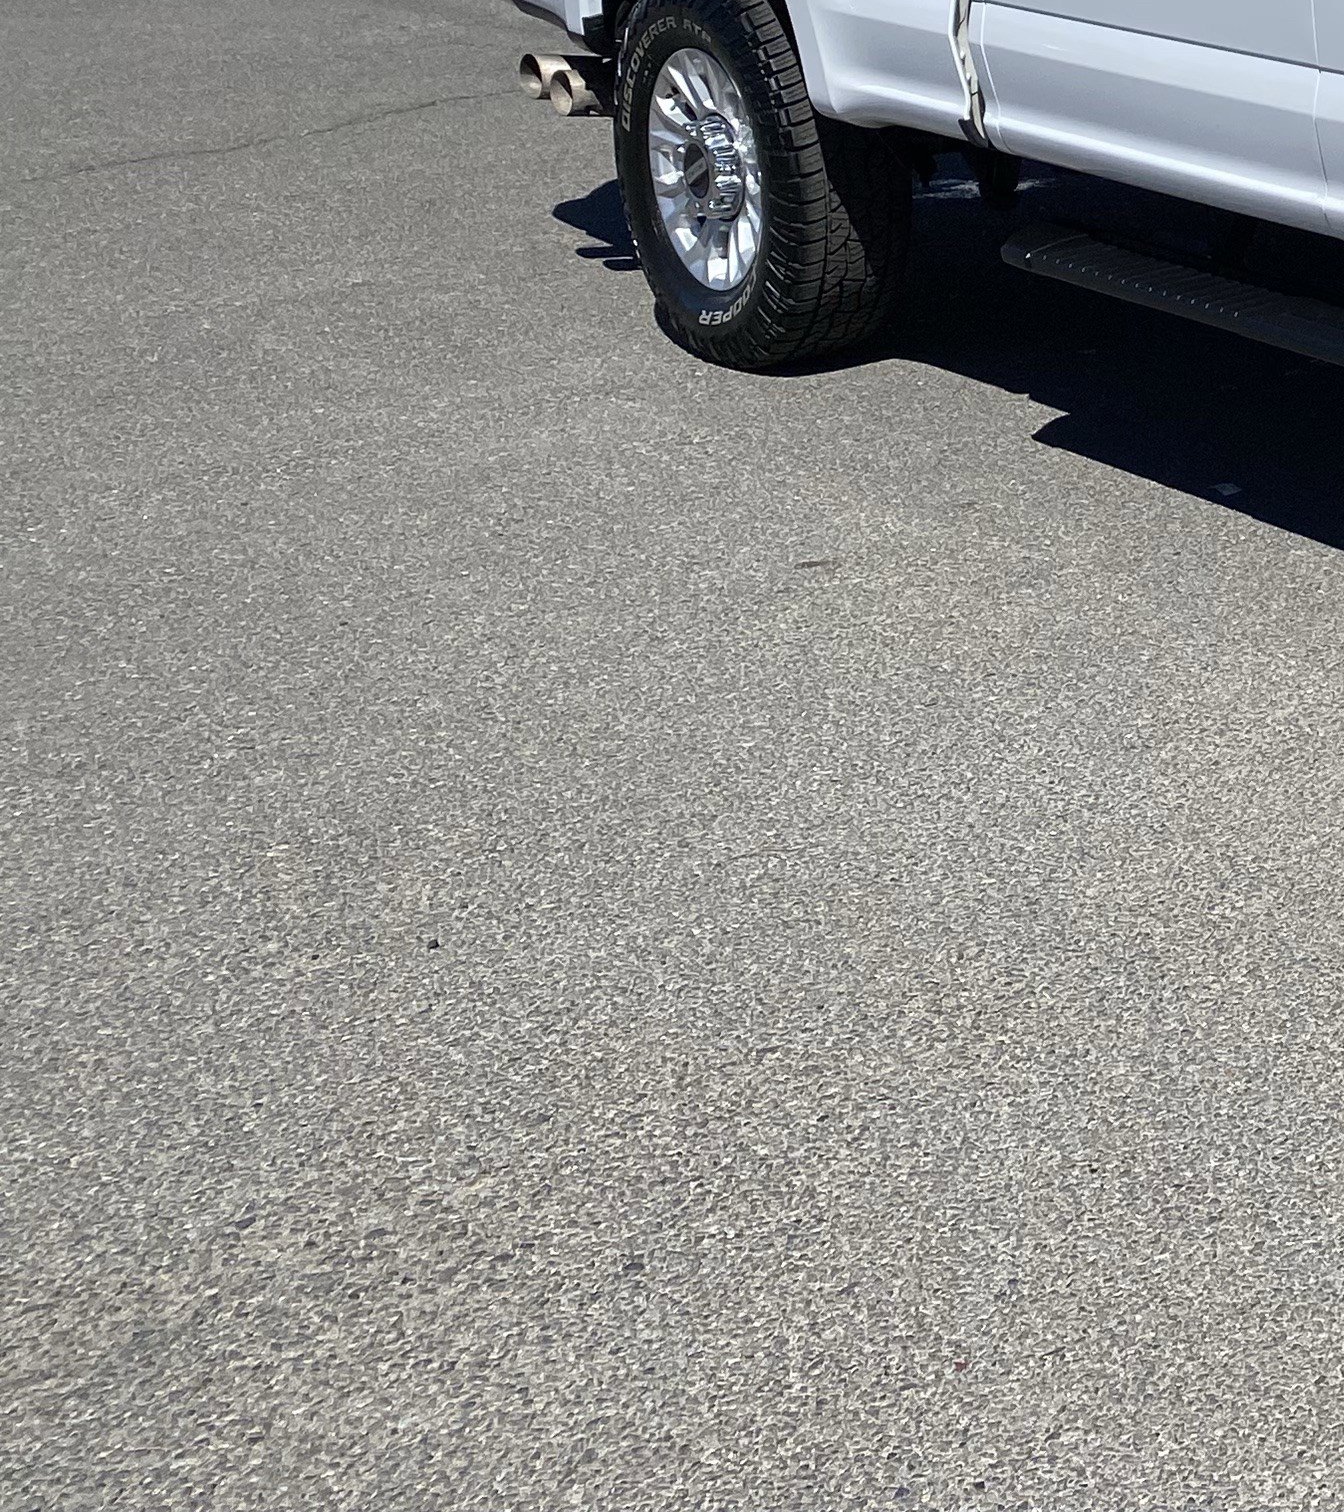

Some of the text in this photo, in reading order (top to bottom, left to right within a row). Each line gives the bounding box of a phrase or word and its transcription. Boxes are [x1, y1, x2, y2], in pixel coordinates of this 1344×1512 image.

[622, 16, 712, 133] DISCOVERER ATP
[699, 268, 757, 326] COOPER
